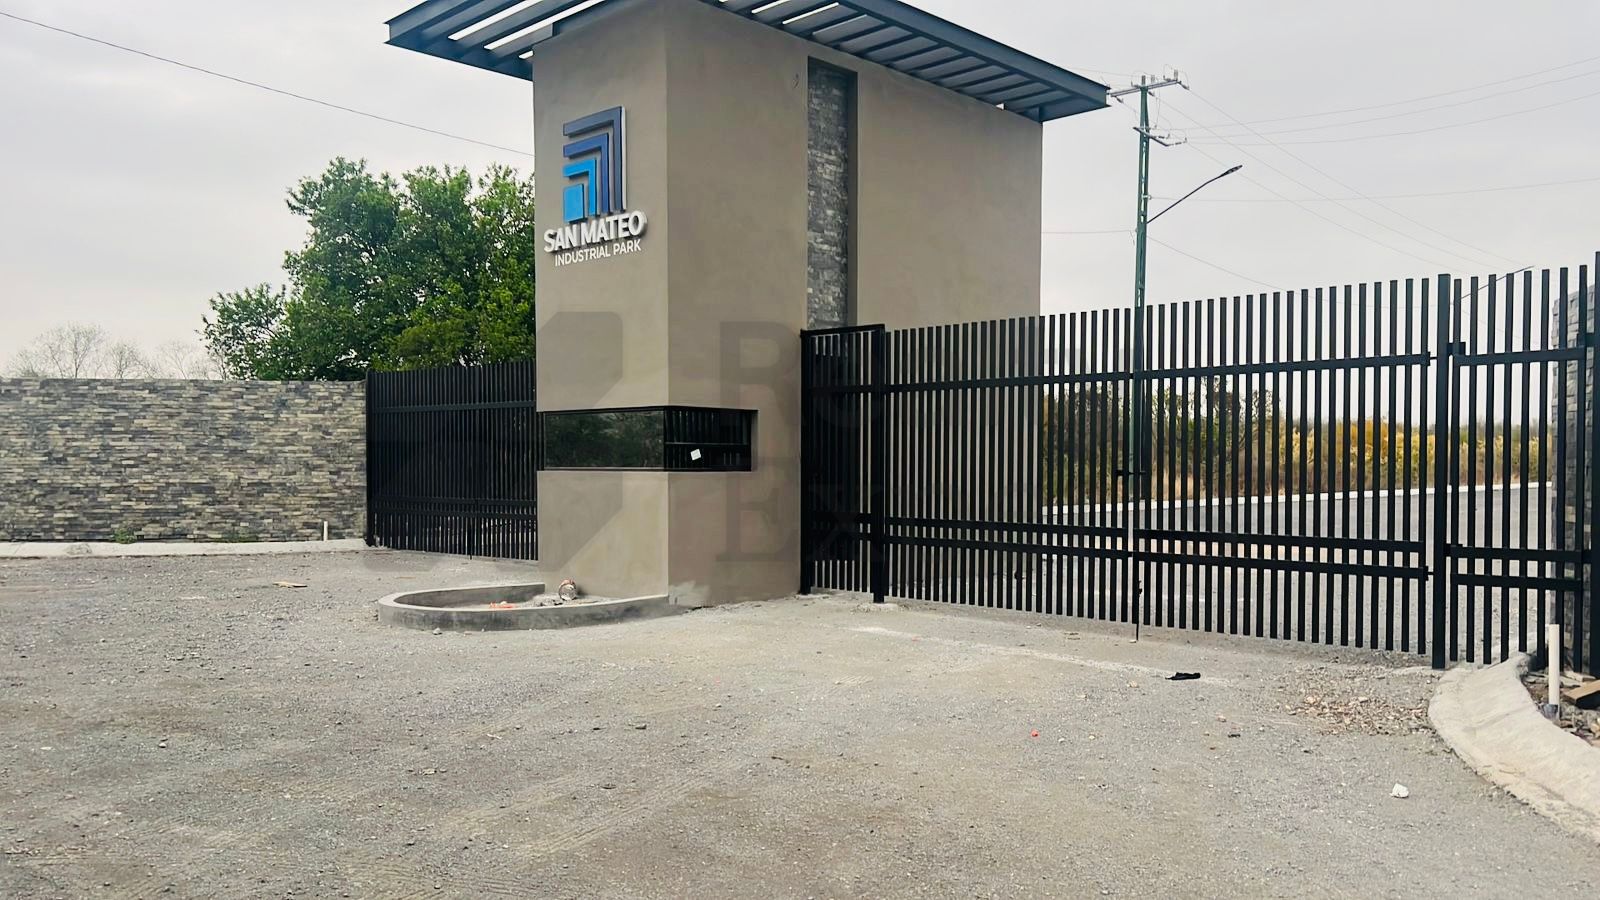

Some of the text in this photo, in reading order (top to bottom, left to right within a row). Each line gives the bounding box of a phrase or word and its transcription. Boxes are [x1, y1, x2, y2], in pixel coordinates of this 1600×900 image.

[544, 211, 646, 252] SAN MATEO
[556, 240, 641, 267] INDUSTRIAL PARK
